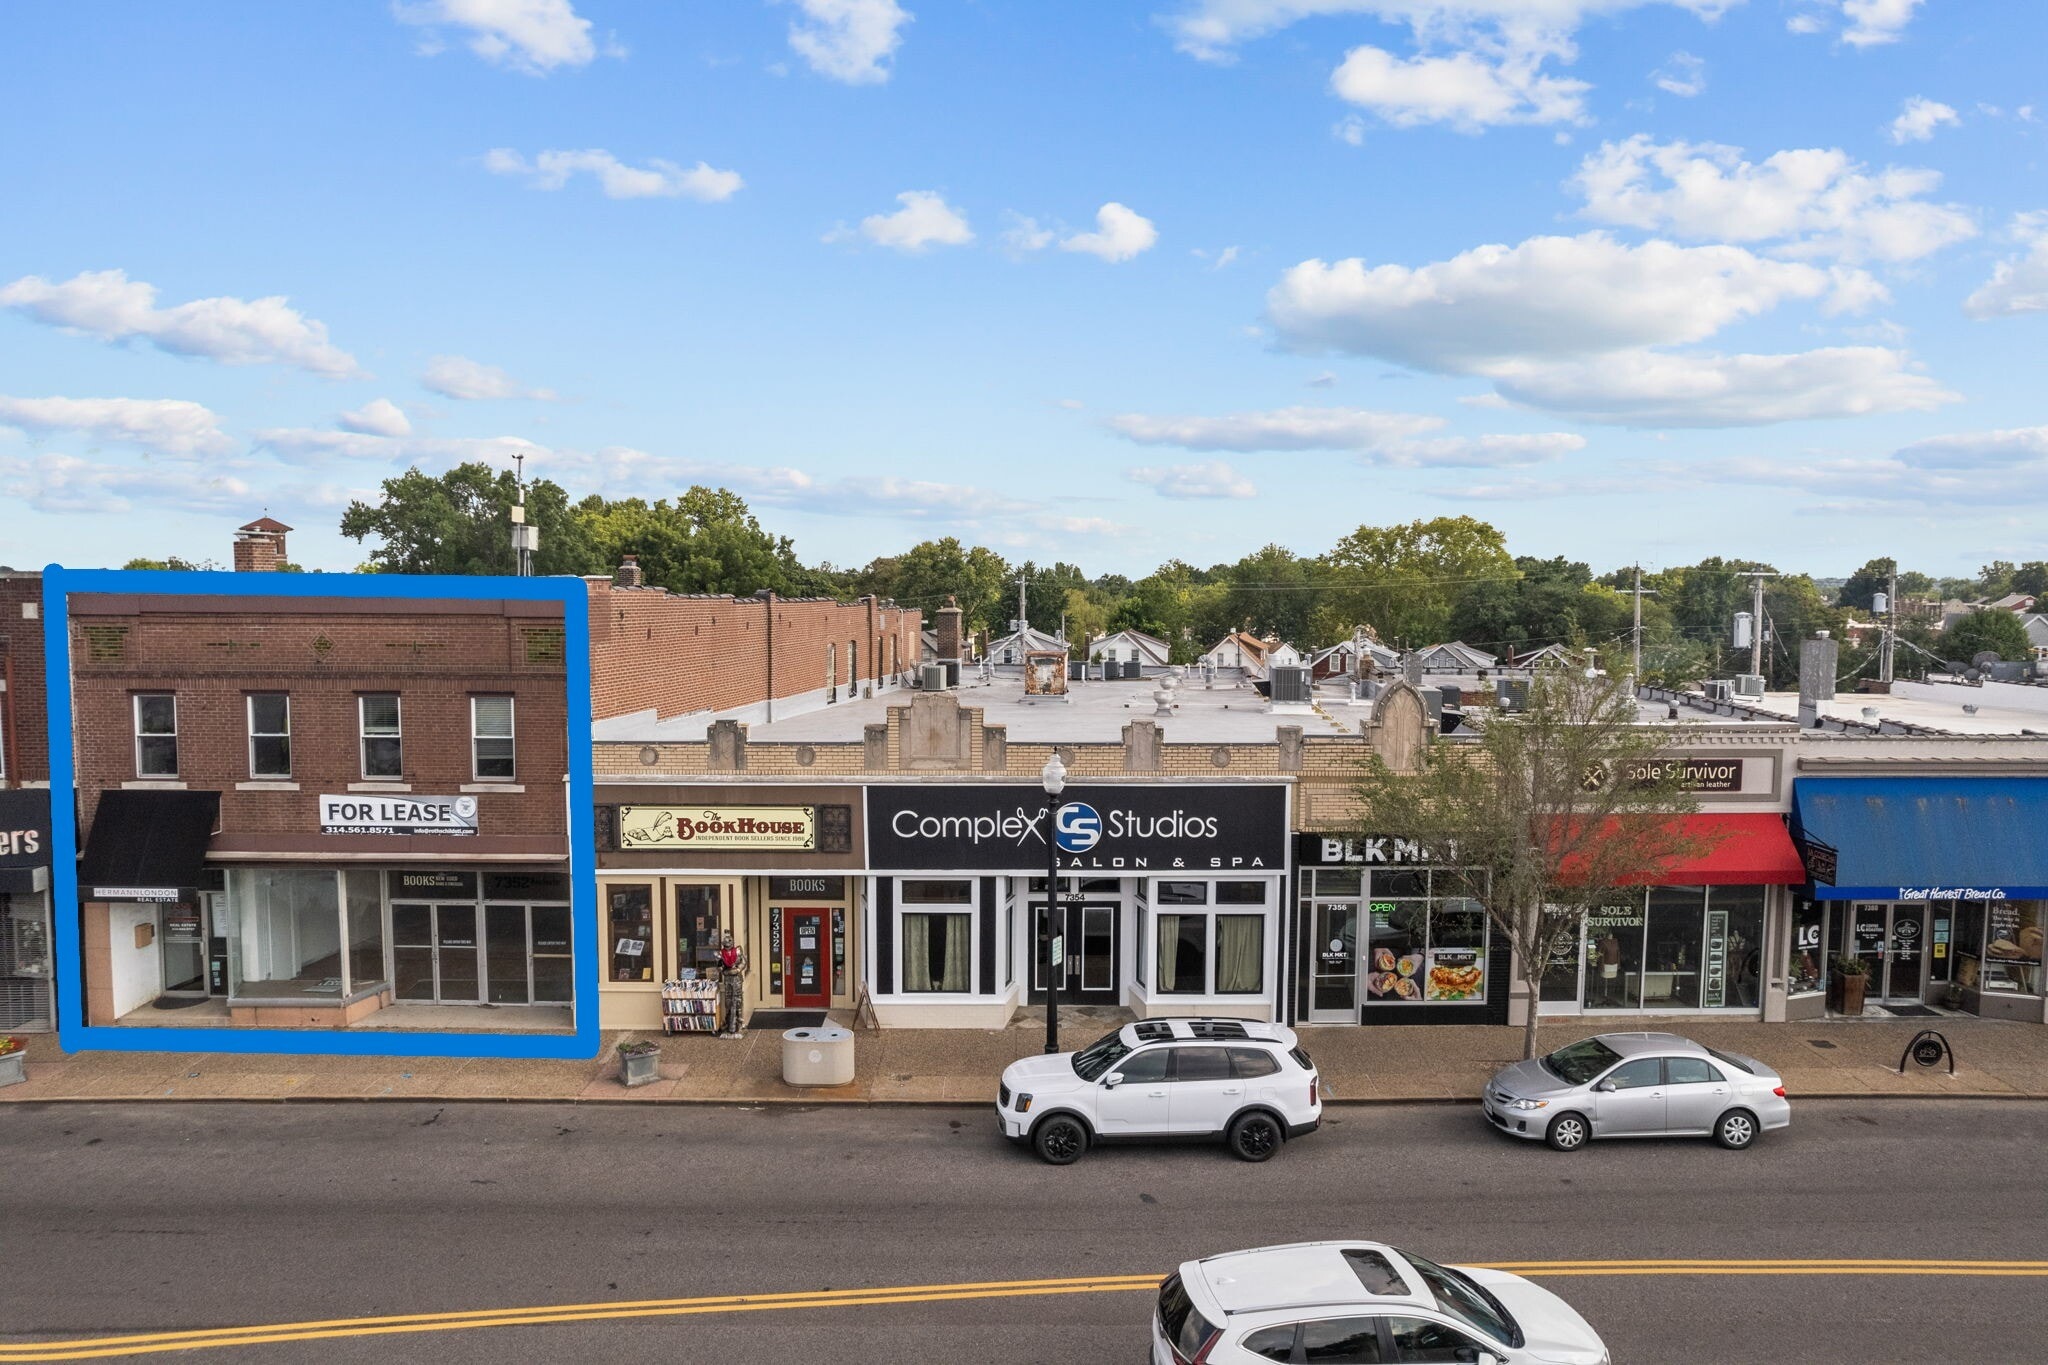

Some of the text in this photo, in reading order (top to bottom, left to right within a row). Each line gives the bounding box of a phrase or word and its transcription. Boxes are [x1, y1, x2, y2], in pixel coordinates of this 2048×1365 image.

[1626, 763, 1661, 780] Sole
[328, 803, 374, 821] FOR
[381, 804, 451, 822] LEASE
[703, 810, 721, 821] The
[325, 826, 395, 834] 314.561.8571
[1056, 807, 1100, 845] CS
[1108, 810, 1218, 839] Studios
[1321, 838, 1388, 862] BLK
[1173, 857, 1184, 867] &
[1210, 857, 1264, 867] SPA
[403, 875, 435, 886] BOOKS
[790, 879, 826, 892] BOOKS
[1064, 893, 1086, 901] 7354
[1904, 888, 1930, 900] Great
[1930, 887, 1965, 899] Harvest
[1964, 888, 1992, 899] Bread
[1369, 903, 1396, 912] OPEN
[1601, 906, 1632, 915] SOLE
[1588, 917, 1644, 926] SURVIVOR
[800, 926, 816, 935] OPEN
[1856, 923, 1866, 932] LC
[1798, 924, 1820, 945] LC
